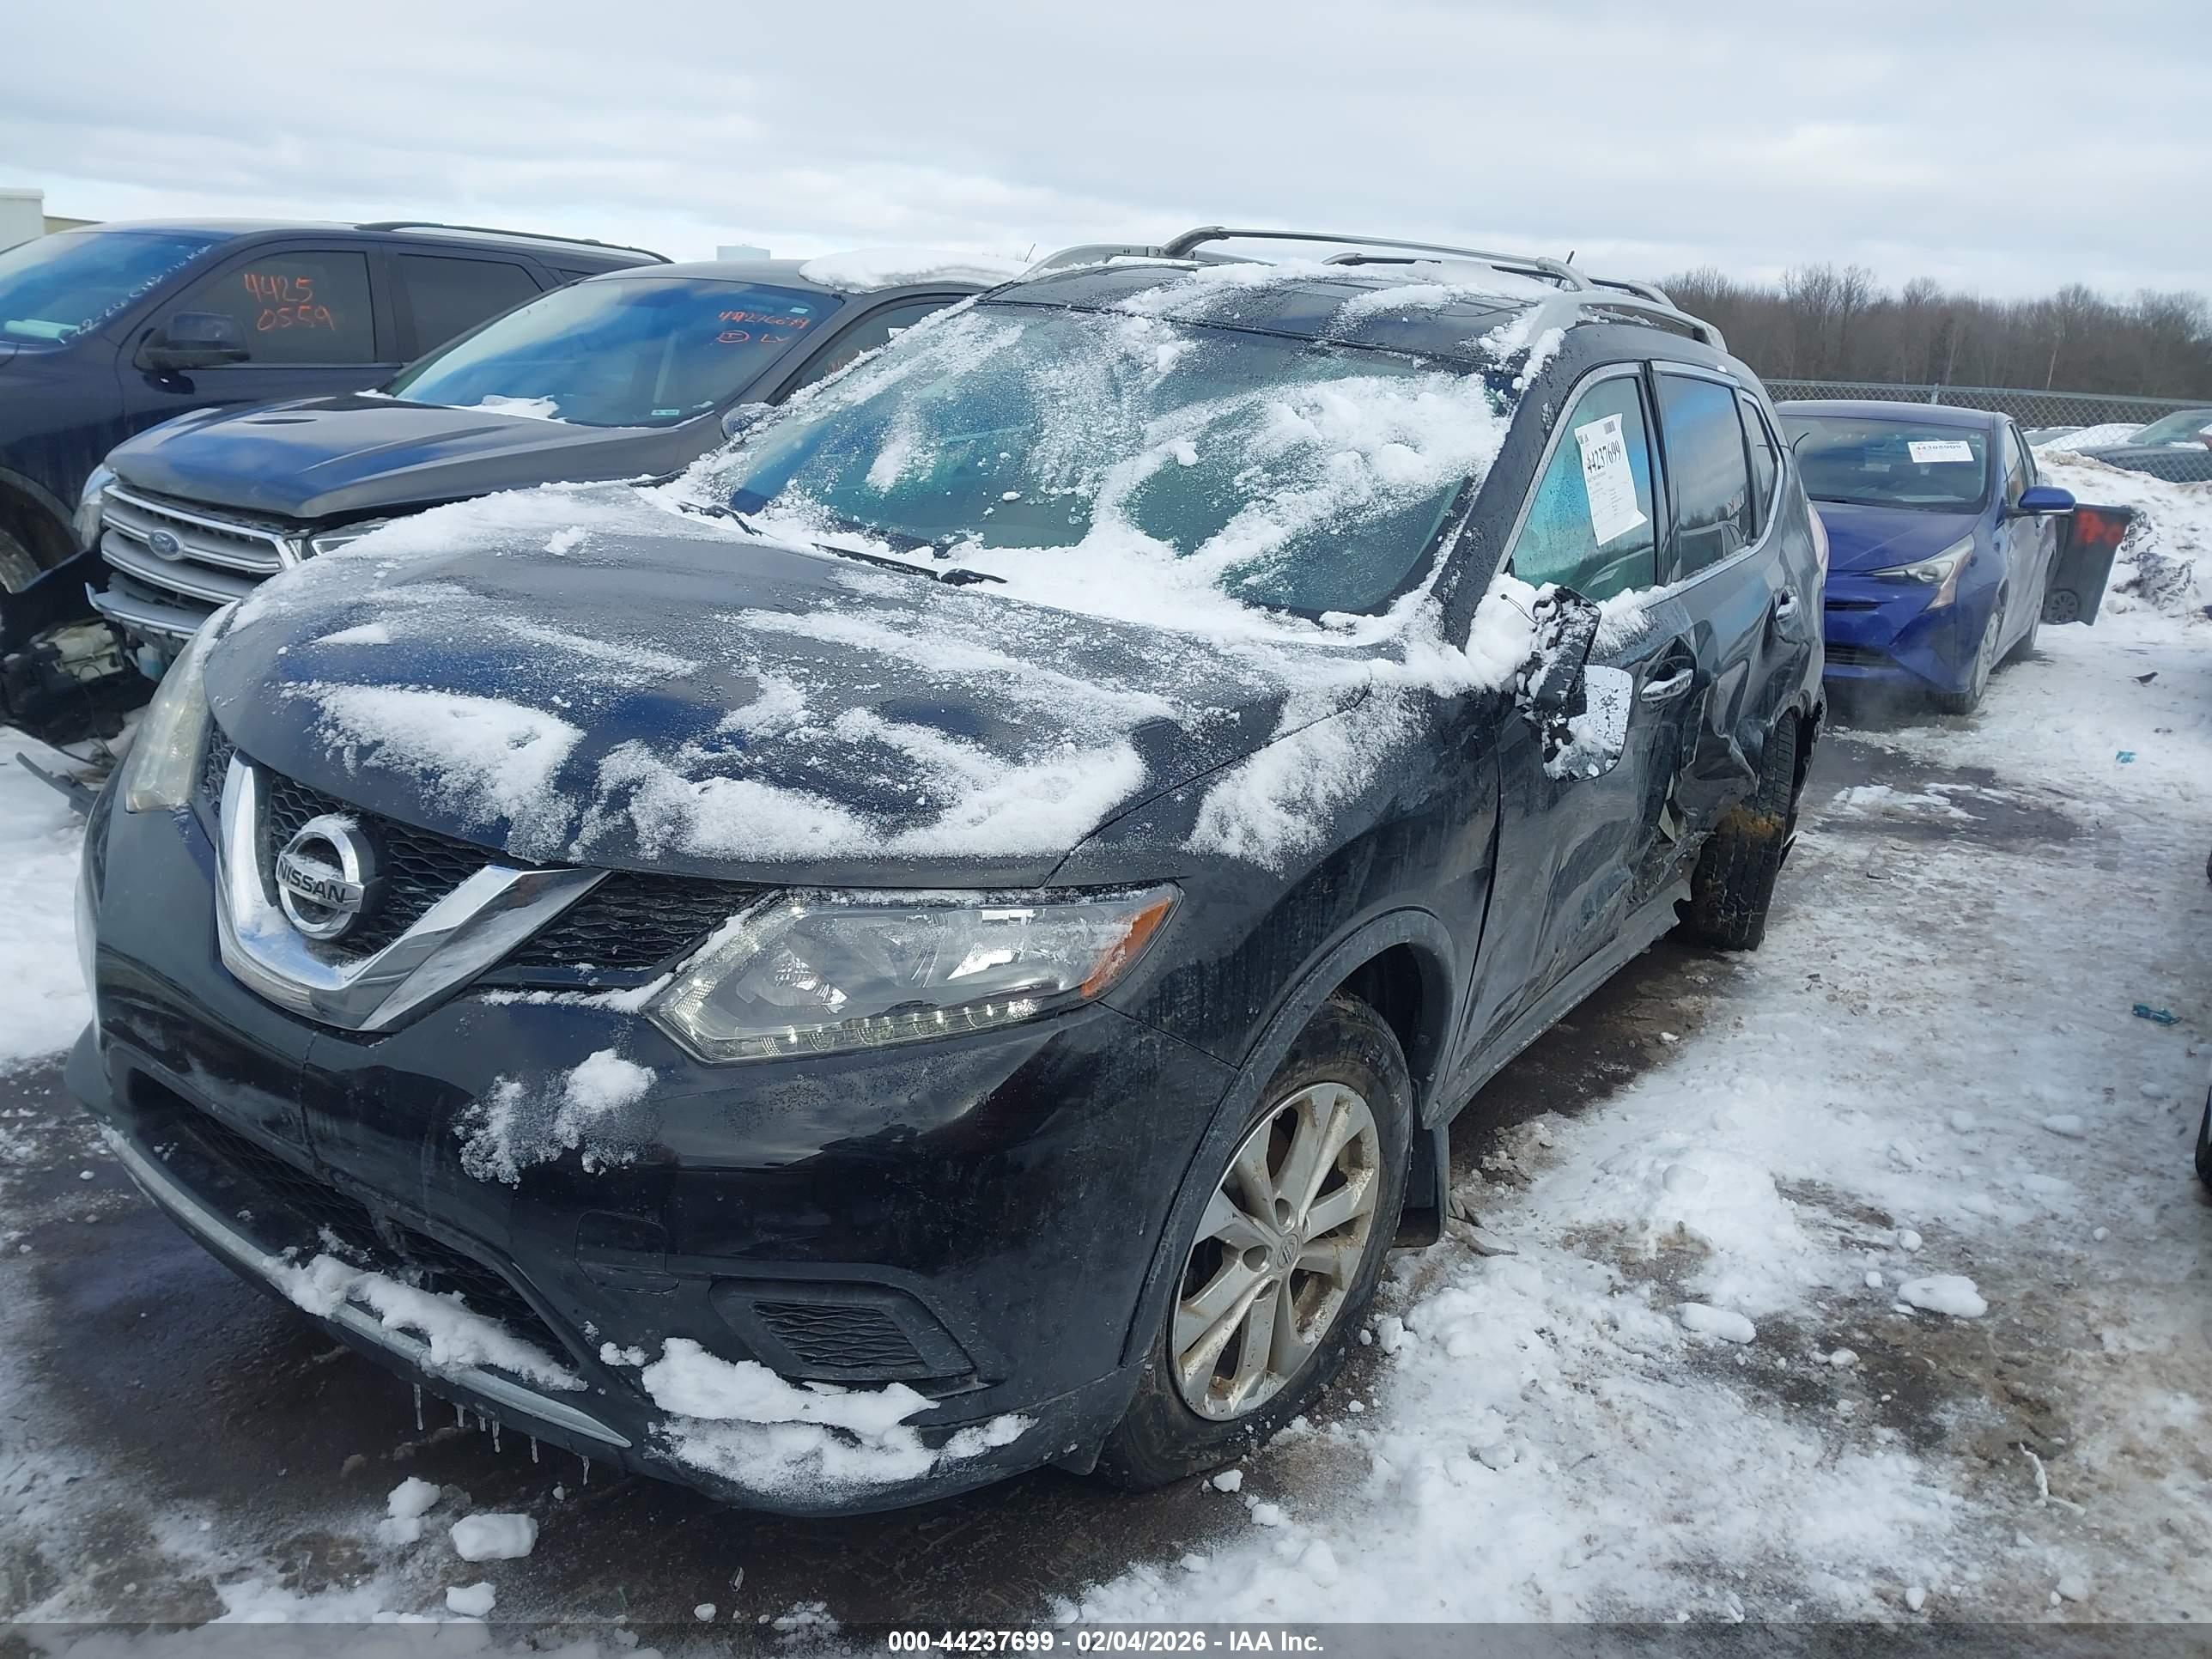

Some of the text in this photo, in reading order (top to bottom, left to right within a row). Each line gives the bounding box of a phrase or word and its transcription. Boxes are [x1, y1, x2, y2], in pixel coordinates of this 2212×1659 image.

[244, 273, 313, 302] 4425
[257, 305, 336, 331] 0559
[1587, 440, 1621, 474] 44237699
[276, 857, 346, 903] NISSAN
